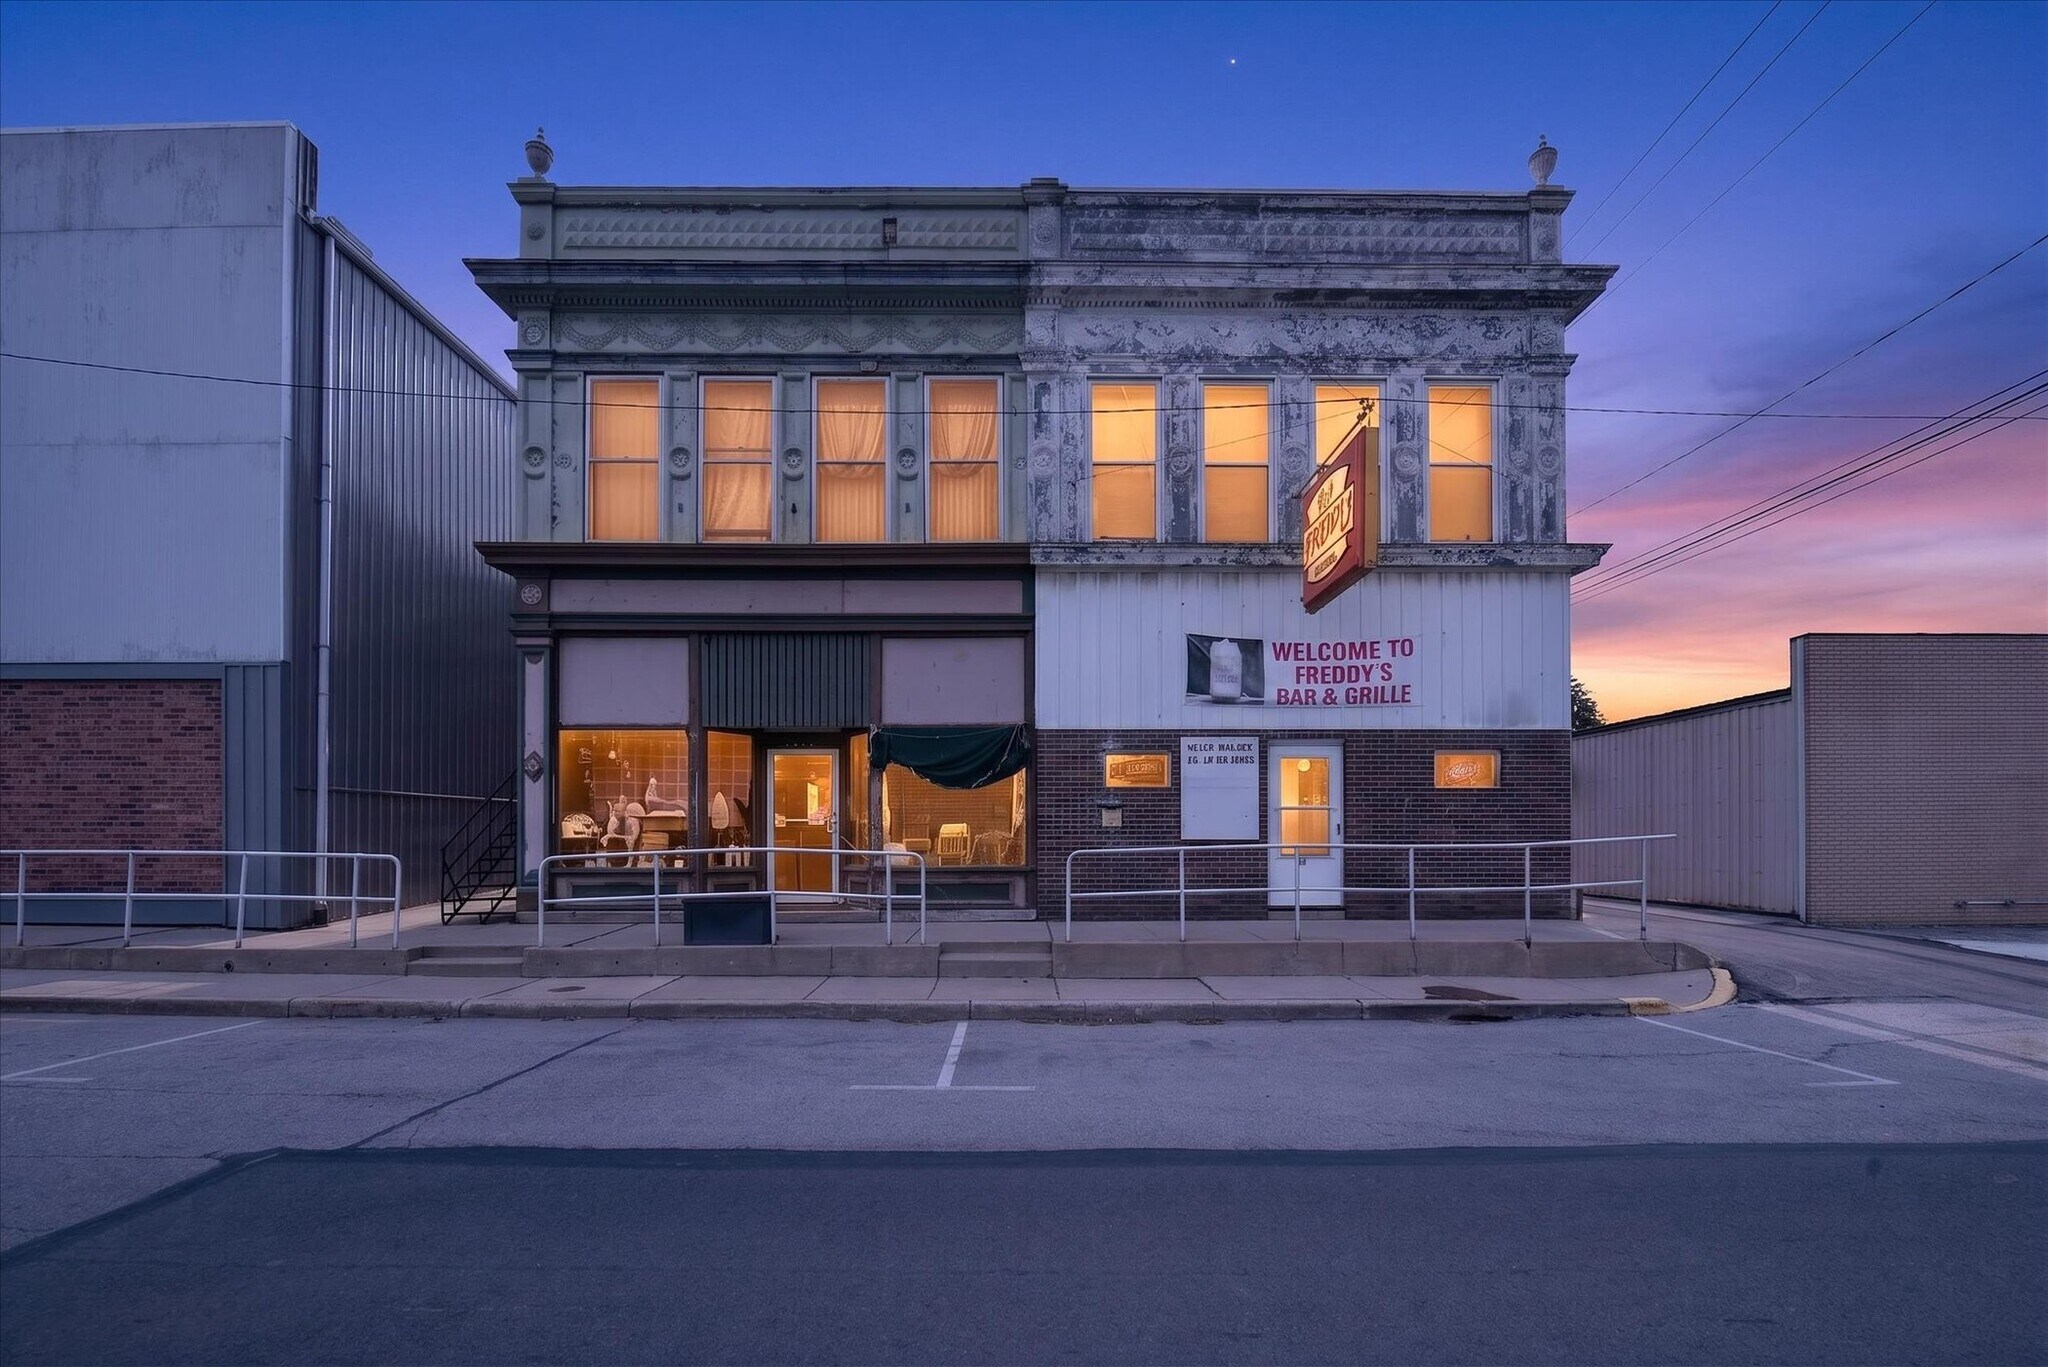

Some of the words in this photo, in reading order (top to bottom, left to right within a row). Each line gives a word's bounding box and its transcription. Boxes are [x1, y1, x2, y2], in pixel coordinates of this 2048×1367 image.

[1272, 641, 1381, 661] WELCOME
[1387, 638, 1414, 658] TO
[1295, 662, 1392, 684] FREDDY'S
[1276, 688, 1317, 705] BAR
[1322, 687, 1338, 705] &
[1345, 685, 1411, 704] GRILLE
